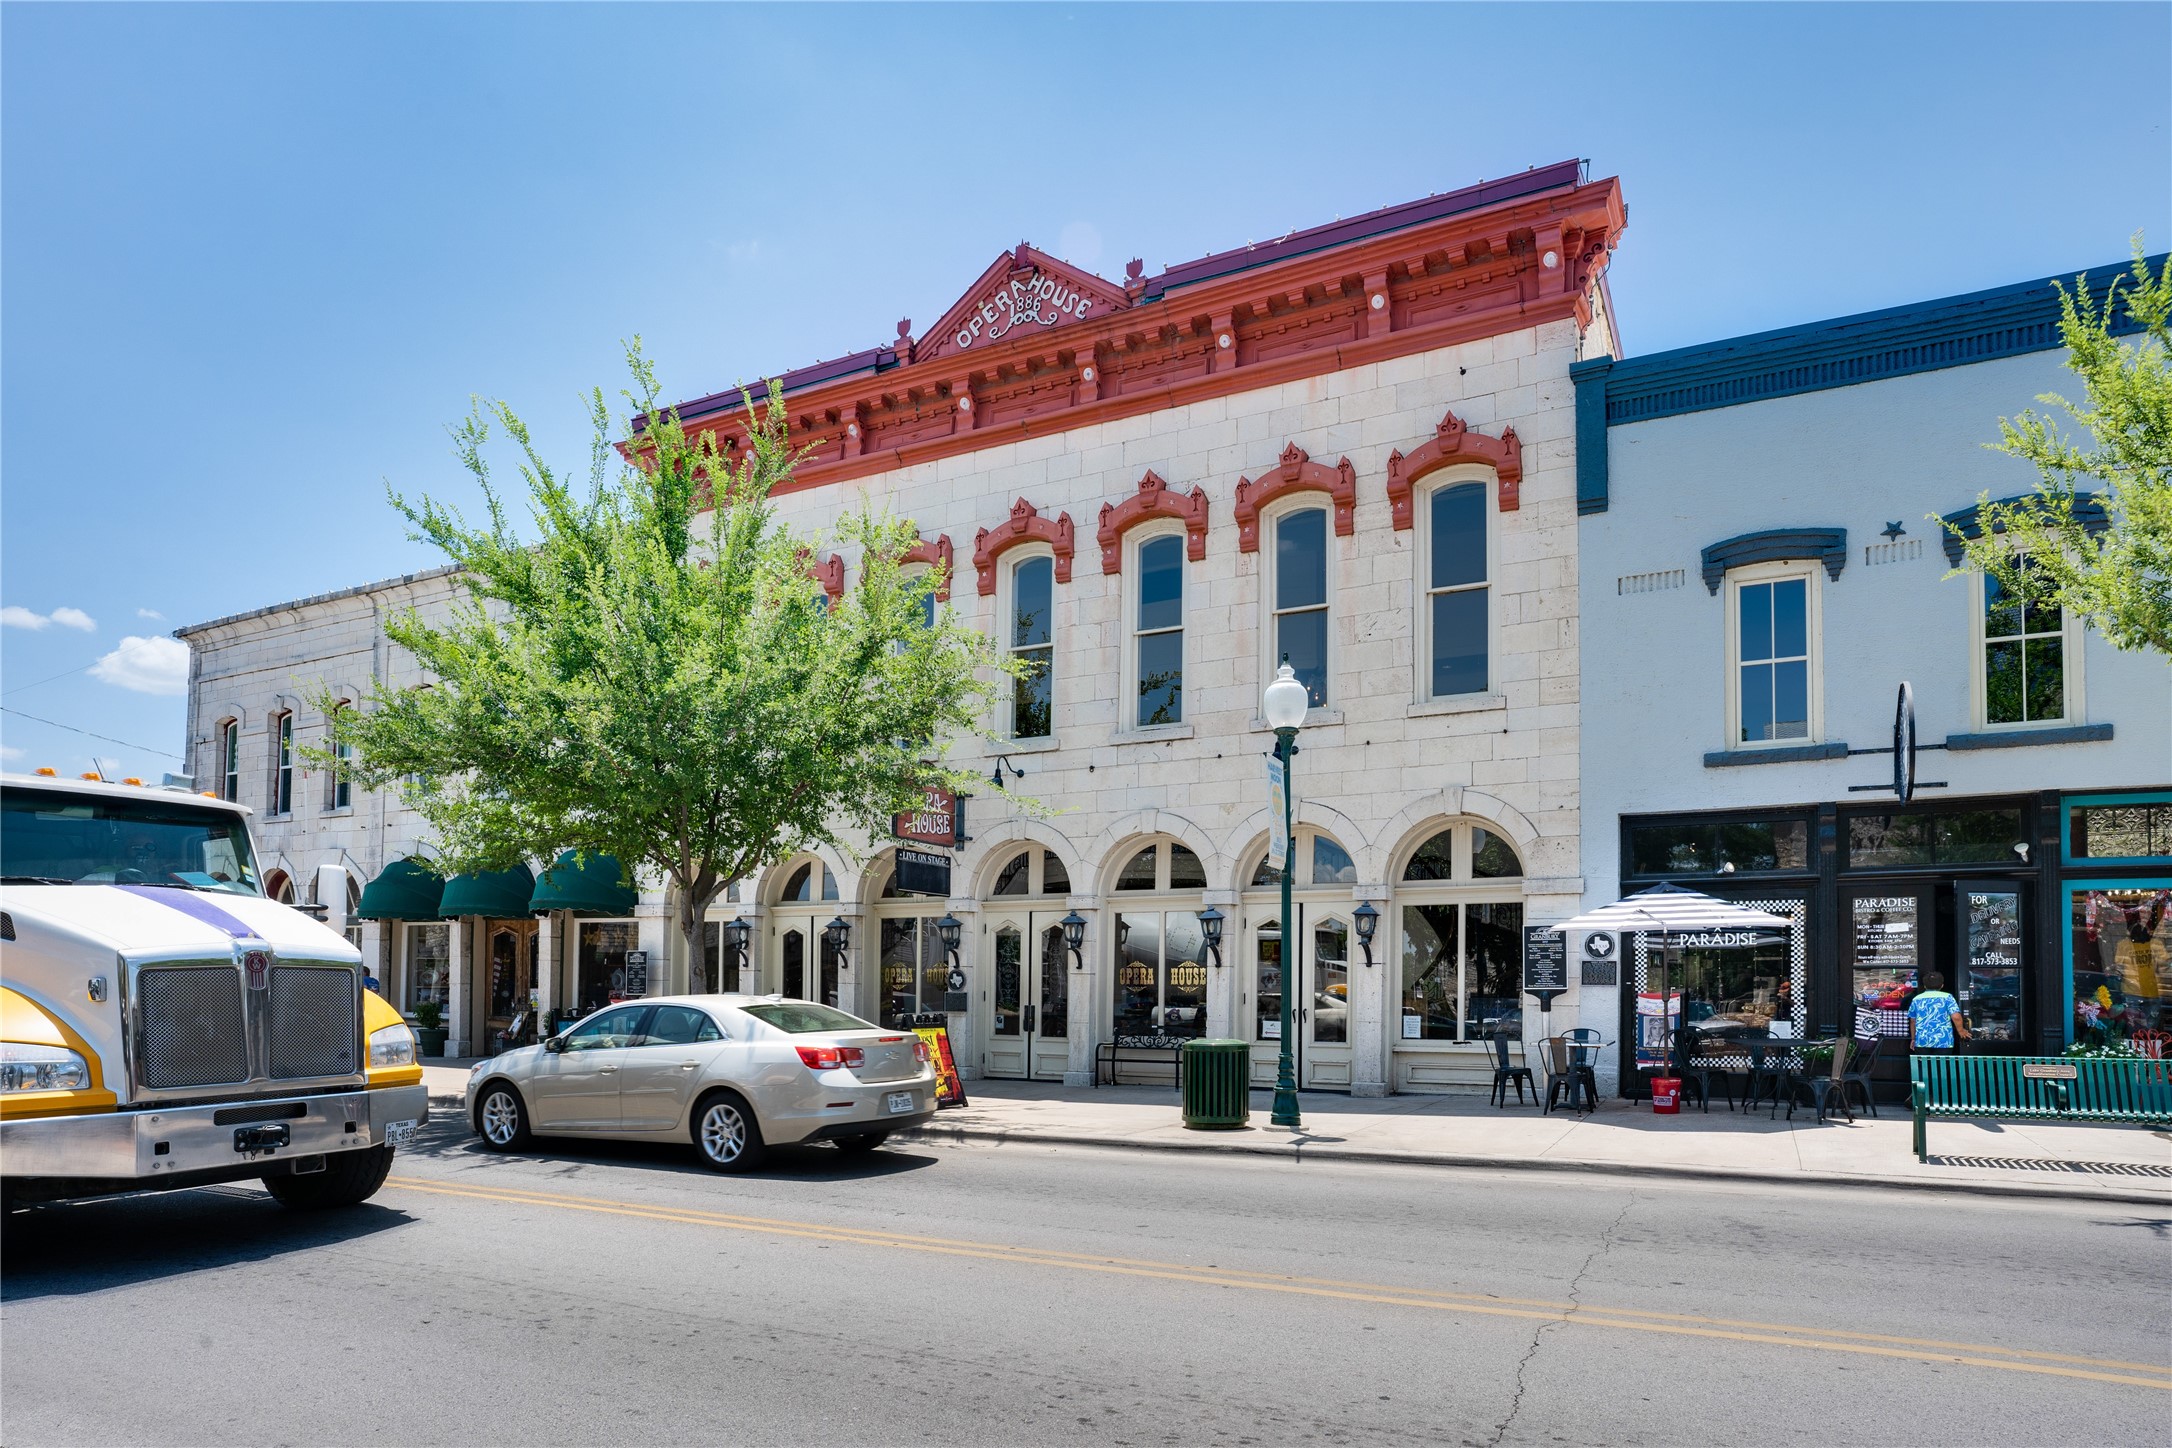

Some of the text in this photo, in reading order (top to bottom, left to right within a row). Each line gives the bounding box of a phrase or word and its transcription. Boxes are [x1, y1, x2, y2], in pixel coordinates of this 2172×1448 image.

[956, 273, 1093, 348] OPERA HOUSE
[1009, 294, 1042, 317] 1886
[904, 812, 951, 835] HOUSE
[902, 851, 946, 866] LIVE ON STAGE
[1855, 897, 1916, 908] PARADISE
[1971, 895, 1988, 905] FOR
[1970, 896, 2016, 924] DELIVERY
[1679, 932, 1758, 946] PARADISE
[1969, 921, 2019, 949] CATERING
[2000, 937, 2021, 945] NEEDS
[1971, 957, 2018, 966] 817-573-3853
[1985, 951, 2004, 959] CALL
[884, 967, 949, 984] OPERA HOUS
[1119, 967, 1207, 986] OPERA HOUSE
[1879, 990, 1905, 999] OPEN
